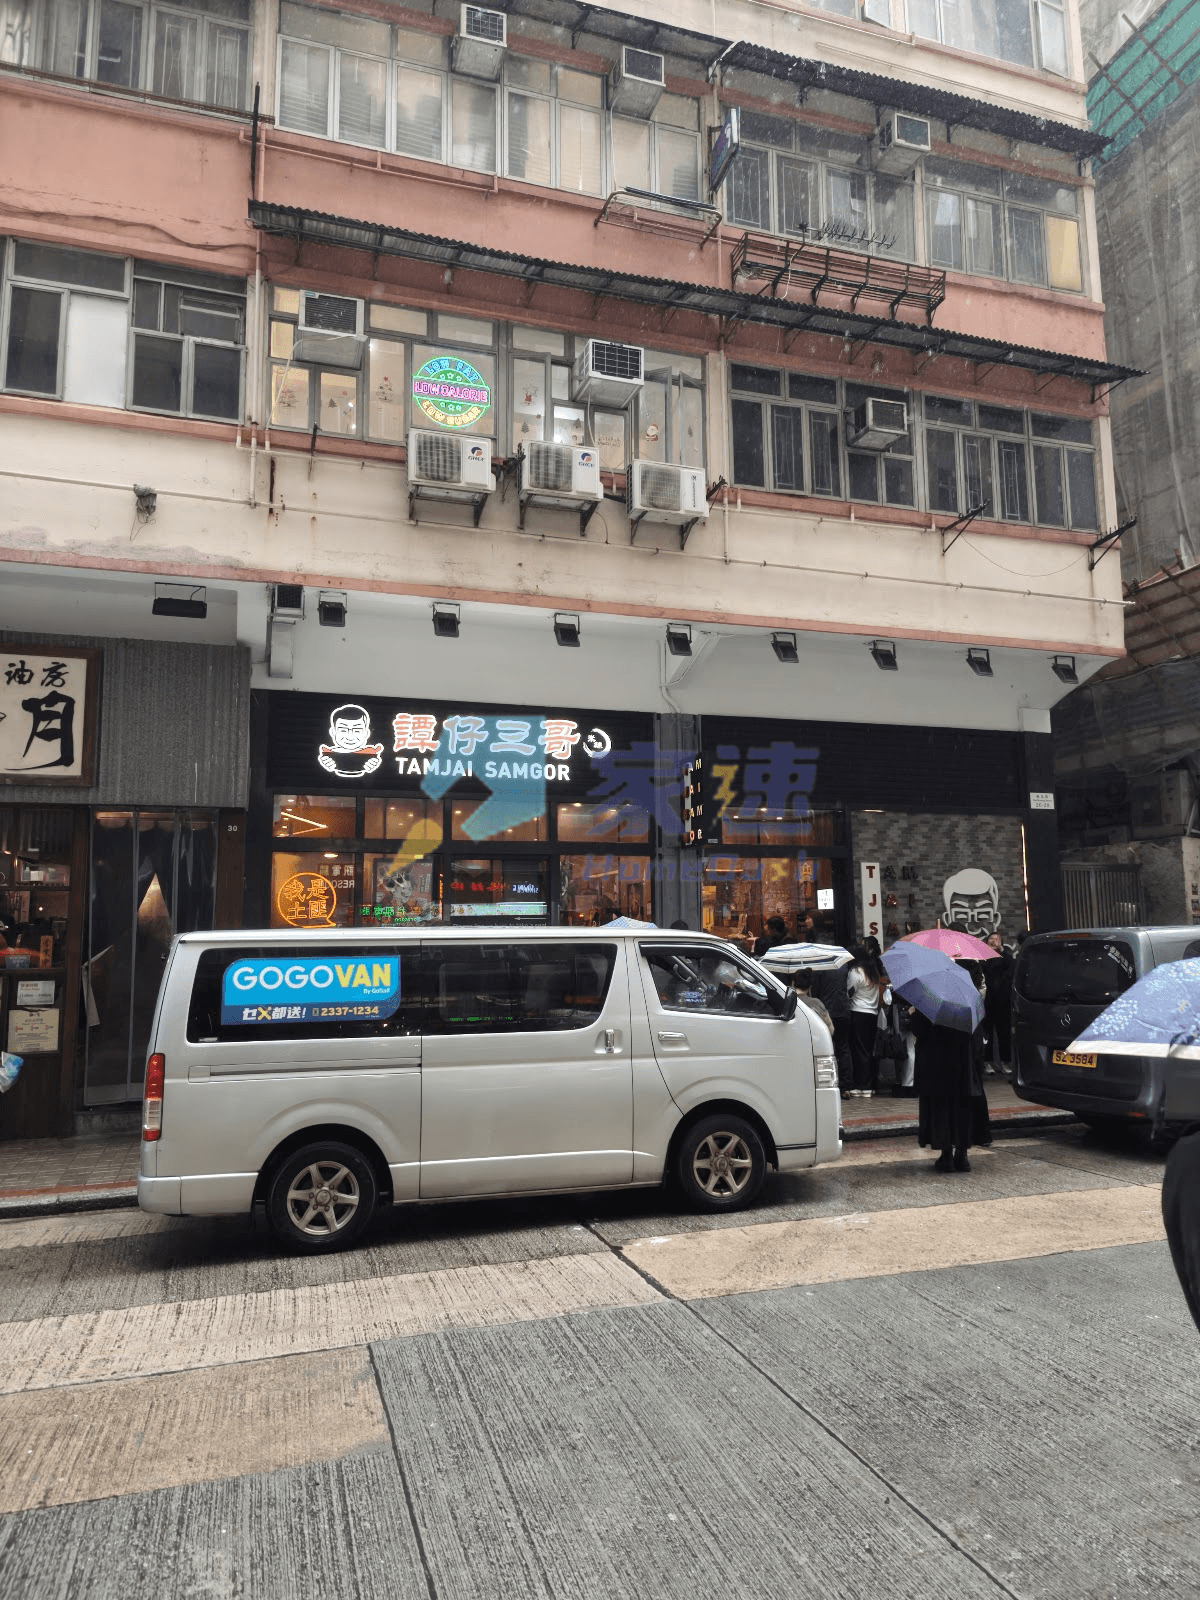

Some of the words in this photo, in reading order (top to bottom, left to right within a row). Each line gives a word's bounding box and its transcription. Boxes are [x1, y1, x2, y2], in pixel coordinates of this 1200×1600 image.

[392, 712, 582, 760] 譚仔三哥
[395, 757, 474, 777] TAMJAI
[485, 761, 571, 781] SAMGOR
[227, 824, 238, 832] 30
[232, 963, 391, 991] GOGOVAN
[320, 1006, 379, 1017] 2337-1234
